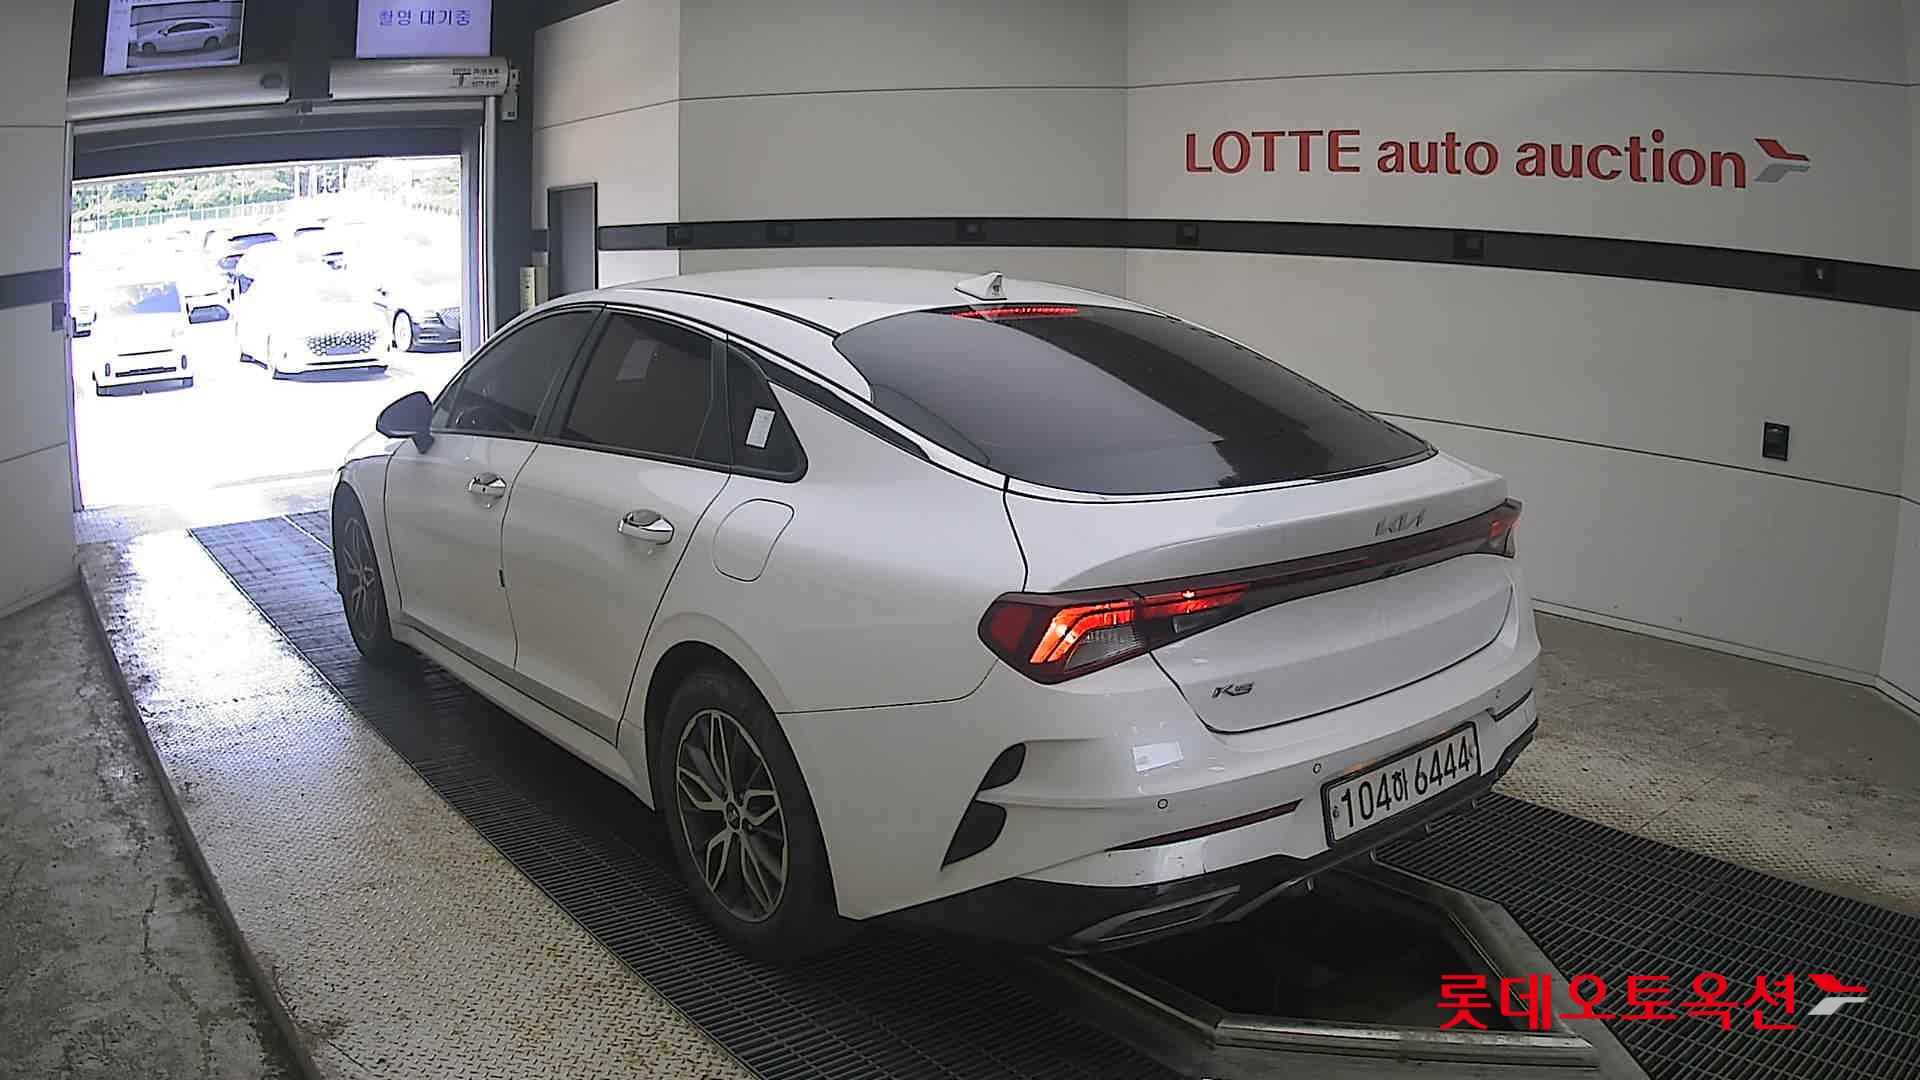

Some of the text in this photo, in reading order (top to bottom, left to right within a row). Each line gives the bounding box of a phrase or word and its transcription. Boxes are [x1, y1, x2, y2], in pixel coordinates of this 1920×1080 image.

[420, 9, 472, 26] 대기중
[1185, 129, 1746, 188] LOTTE auto auction
[1211, 682, 1255, 698] K5
